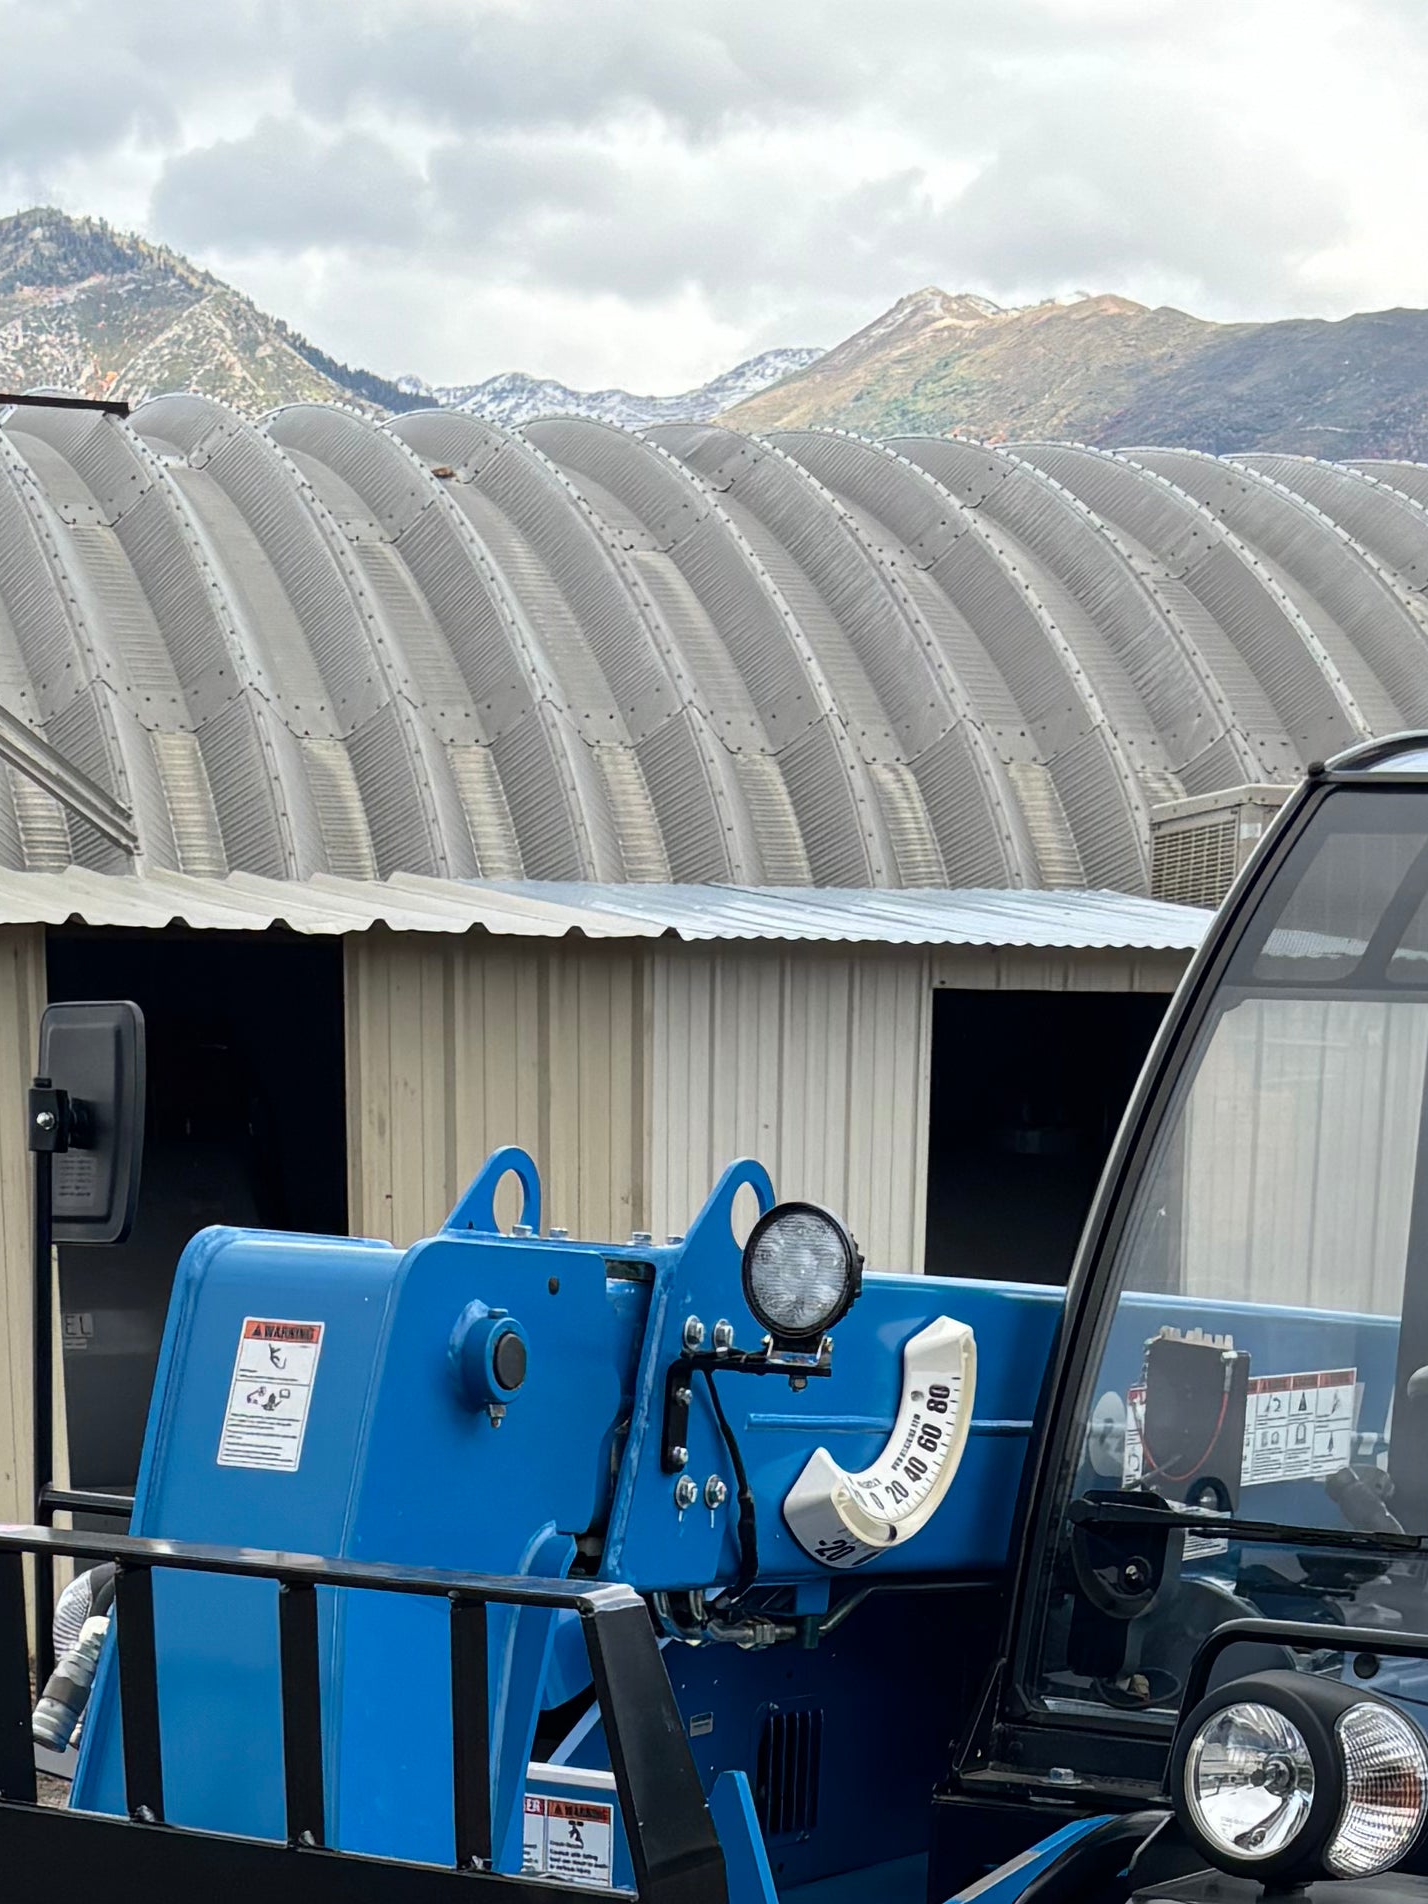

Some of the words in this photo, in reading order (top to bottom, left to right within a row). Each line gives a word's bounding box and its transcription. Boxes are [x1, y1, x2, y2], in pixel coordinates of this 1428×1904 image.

[927, 1384, 950, 1414] 80
[917, 1423, 942, 1453] 60
[903, 1456, 928, 1483] 40
[869, 1492, 885, 1511] 0
[885, 1480, 909, 1504] 20
[815, 1539, 856, 1562] -20
